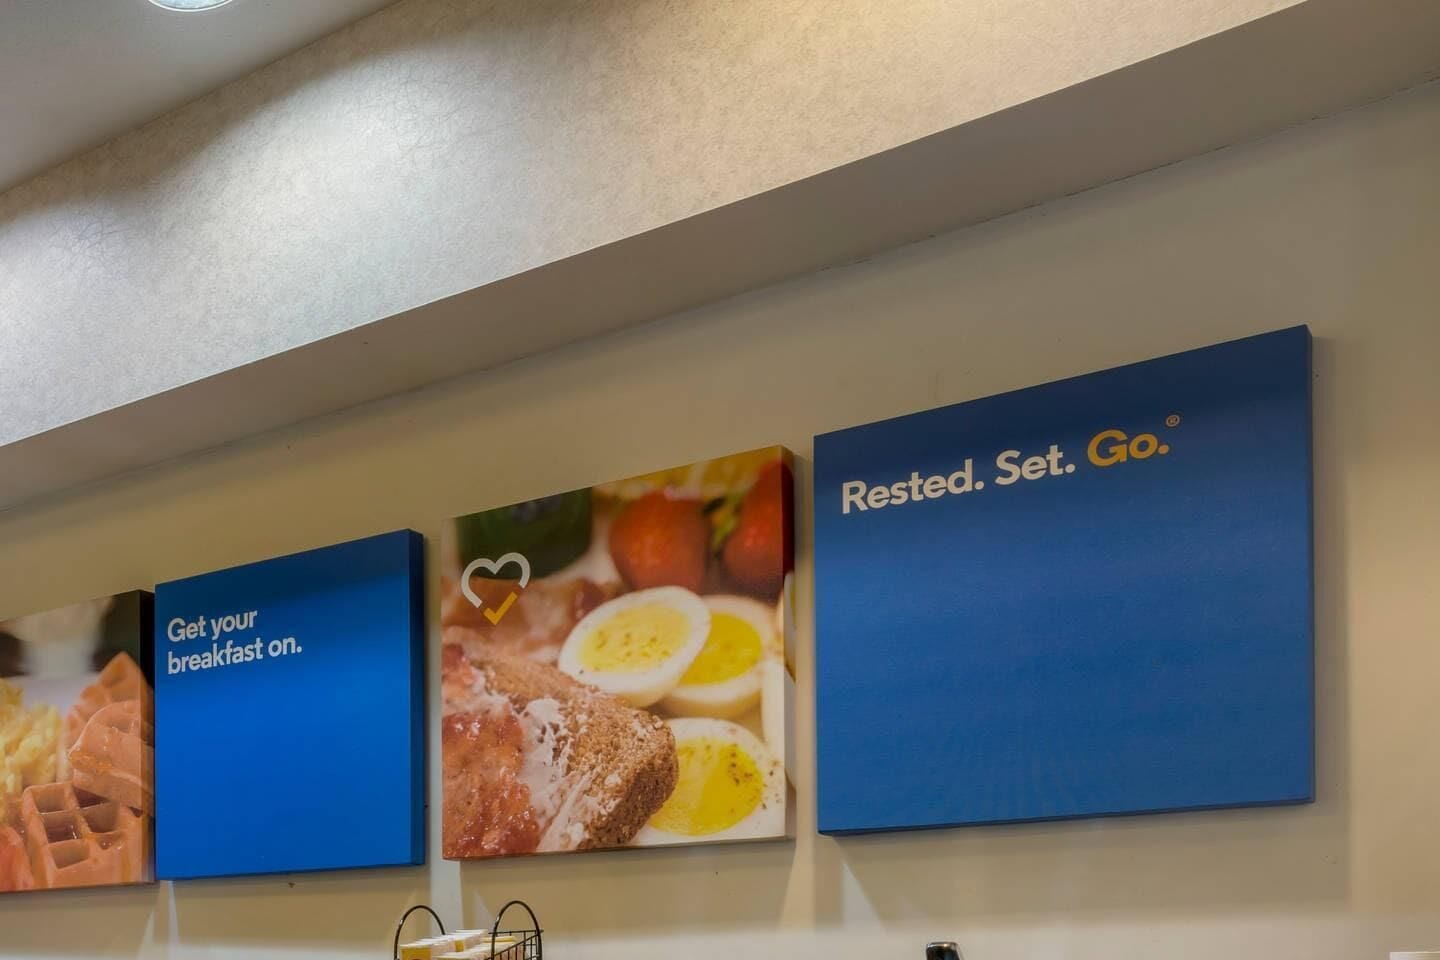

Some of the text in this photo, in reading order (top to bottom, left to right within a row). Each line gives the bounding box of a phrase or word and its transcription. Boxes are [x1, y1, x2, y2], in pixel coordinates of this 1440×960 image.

[841, 458, 985, 515] Rested.
[994, 444, 1076, 486] Set.
[167, 610, 258, 643] Get your
[167, 636, 303, 675] breakfast on.
